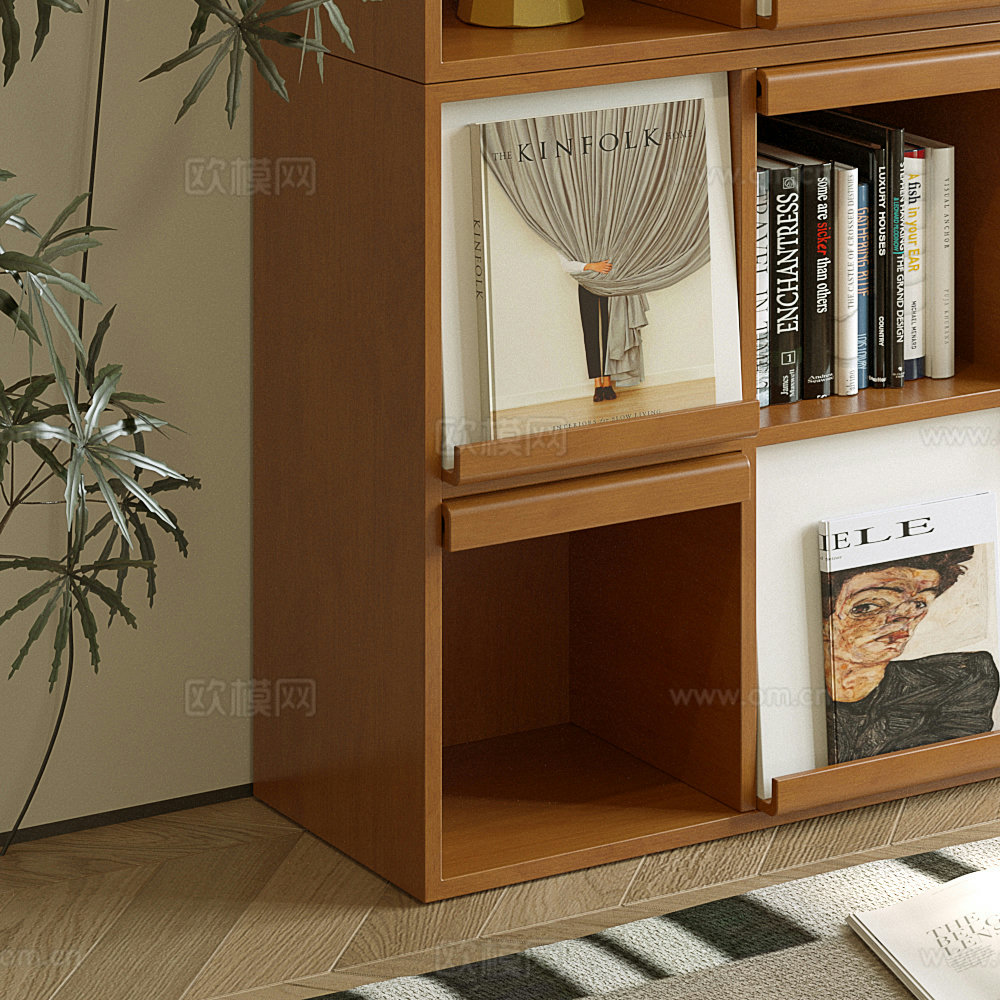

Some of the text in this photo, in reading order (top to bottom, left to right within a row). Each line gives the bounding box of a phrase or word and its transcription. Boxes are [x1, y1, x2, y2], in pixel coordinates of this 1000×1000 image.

[493, 151, 513, 162] THE
[518, 127, 662, 163] KINFOLK
[878, 166, 886, 256] LUXURY HOUSES
[908, 182, 921, 204] fish
[909, 207, 920, 218] in
[473, 219, 484, 300] KINFOLK
[816, 177, 831, 314] some are sicker than others
[906, 220, 919, 246] your
[909, 248, 920, 272] EAR
[777, 192, 800, 334] ENCHANTRESS
[896, 255, 904, 343] THE GRAND DESIGN
